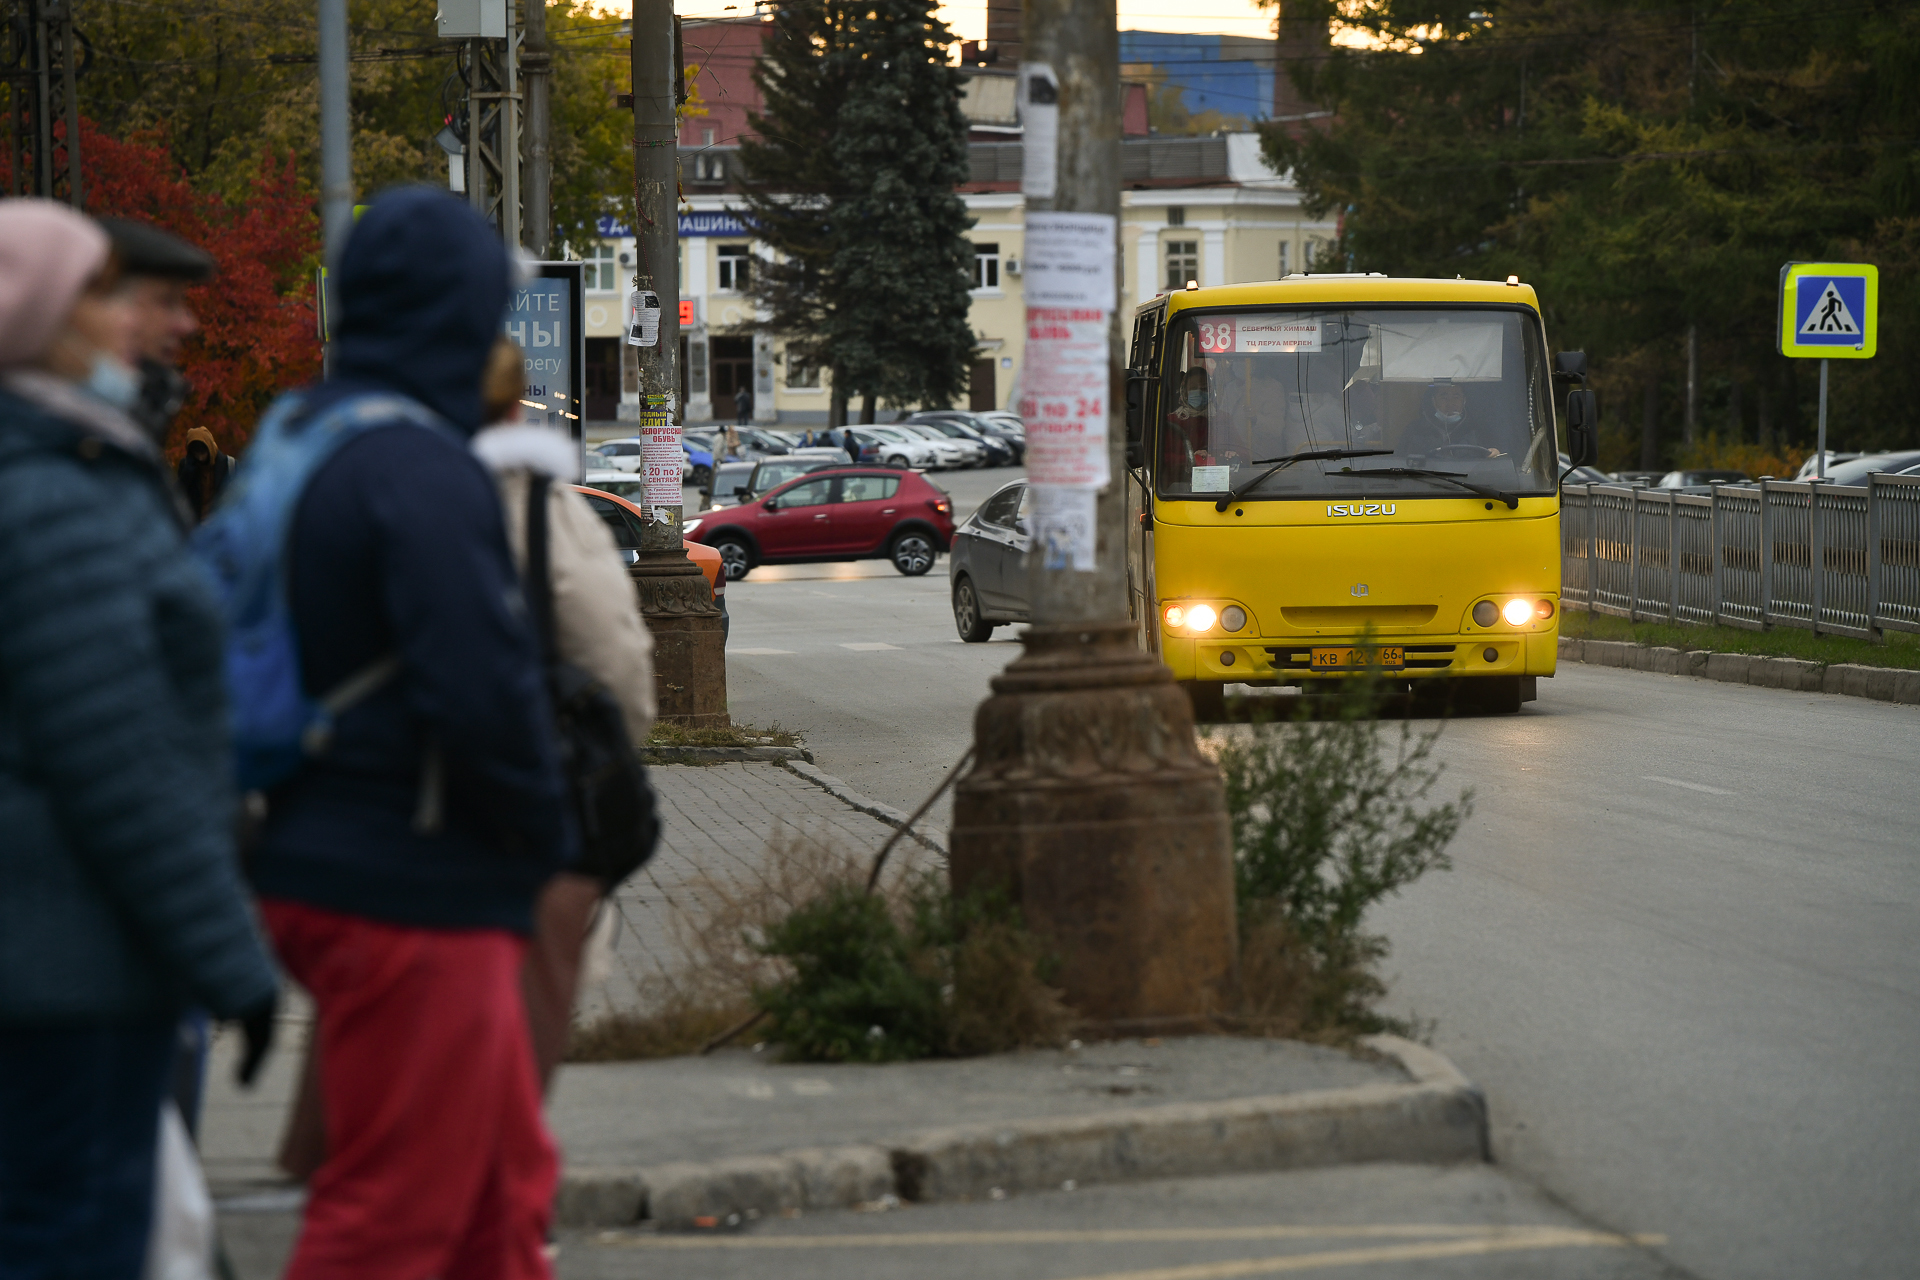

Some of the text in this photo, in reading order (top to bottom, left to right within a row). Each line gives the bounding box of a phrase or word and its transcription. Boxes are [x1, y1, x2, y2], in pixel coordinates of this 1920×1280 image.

[1242, 324, 1282, 332] СЕВЕРНЫЙ
[1200, 323, 1232, 350] 38
[652, 435, 676, 443] ОБУВЬ
[649, 467, 660, 476] 20
[1327, 503, 1396, 517] ISUZU
[1383, 648, 1398, 660] 66
